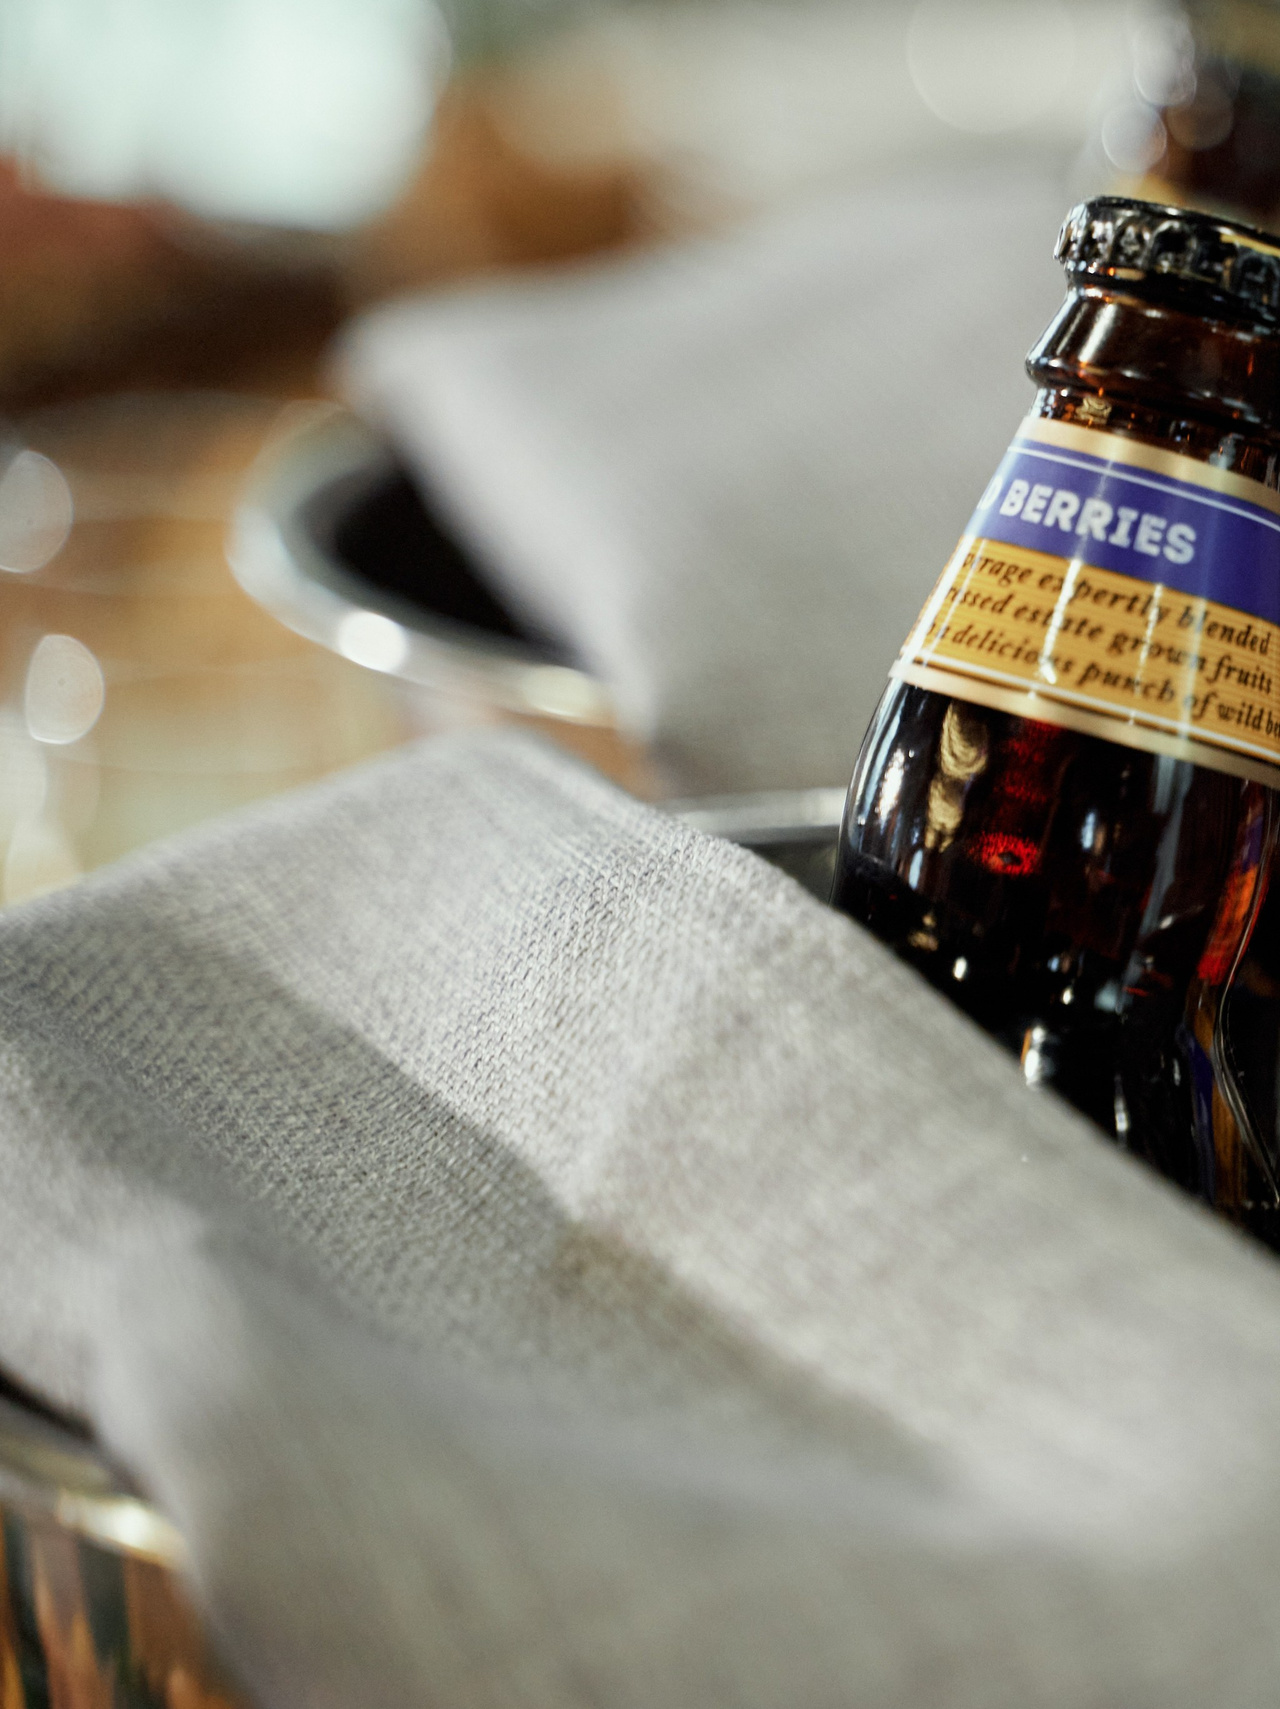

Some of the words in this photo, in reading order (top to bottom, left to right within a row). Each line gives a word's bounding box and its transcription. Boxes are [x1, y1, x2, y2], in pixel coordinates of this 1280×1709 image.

[999, 479, 1197, 564] BERRIES
[1177, 605, 1272, 656] blended
[1206, 654, 1273, 695] fruits
[1182, 690, 1218, 721] of
[1217, 701, 1265, 731] wild
